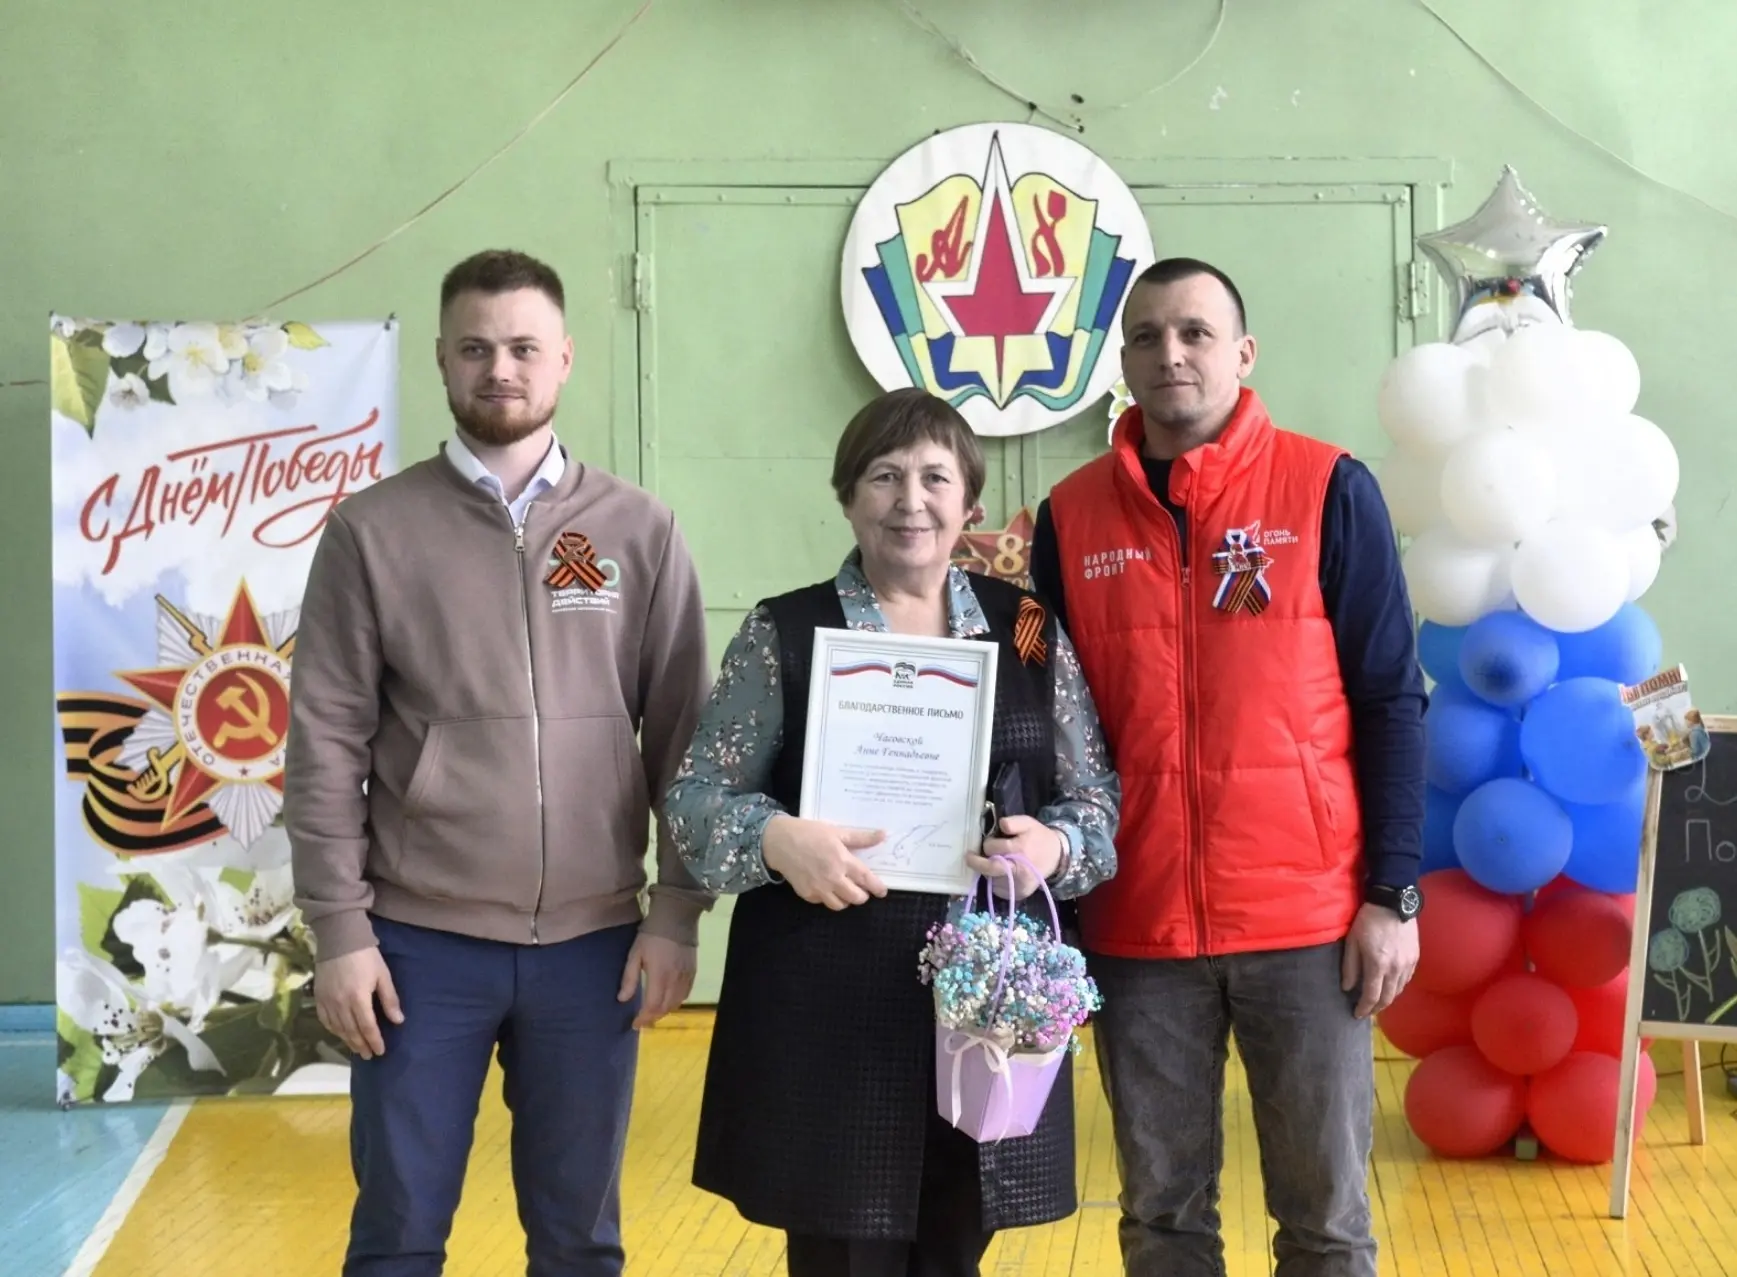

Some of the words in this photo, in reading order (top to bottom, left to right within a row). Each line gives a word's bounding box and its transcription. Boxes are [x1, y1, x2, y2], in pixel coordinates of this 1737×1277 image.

[167, 407, 385, 549] Победы
[102, 455, 236, 574] Днём
[1263, 529, 1291, 538] ОГОНЬ
[1263, 536, 1299, 545] ПАМЯТИ
[1084, 561, 1125, 579] ФРОНТ
[838, 700, 925, 717] БЛАГОДАРСТВЕННОЕ
[927, 708, 964, 720] ПИСЬМО
